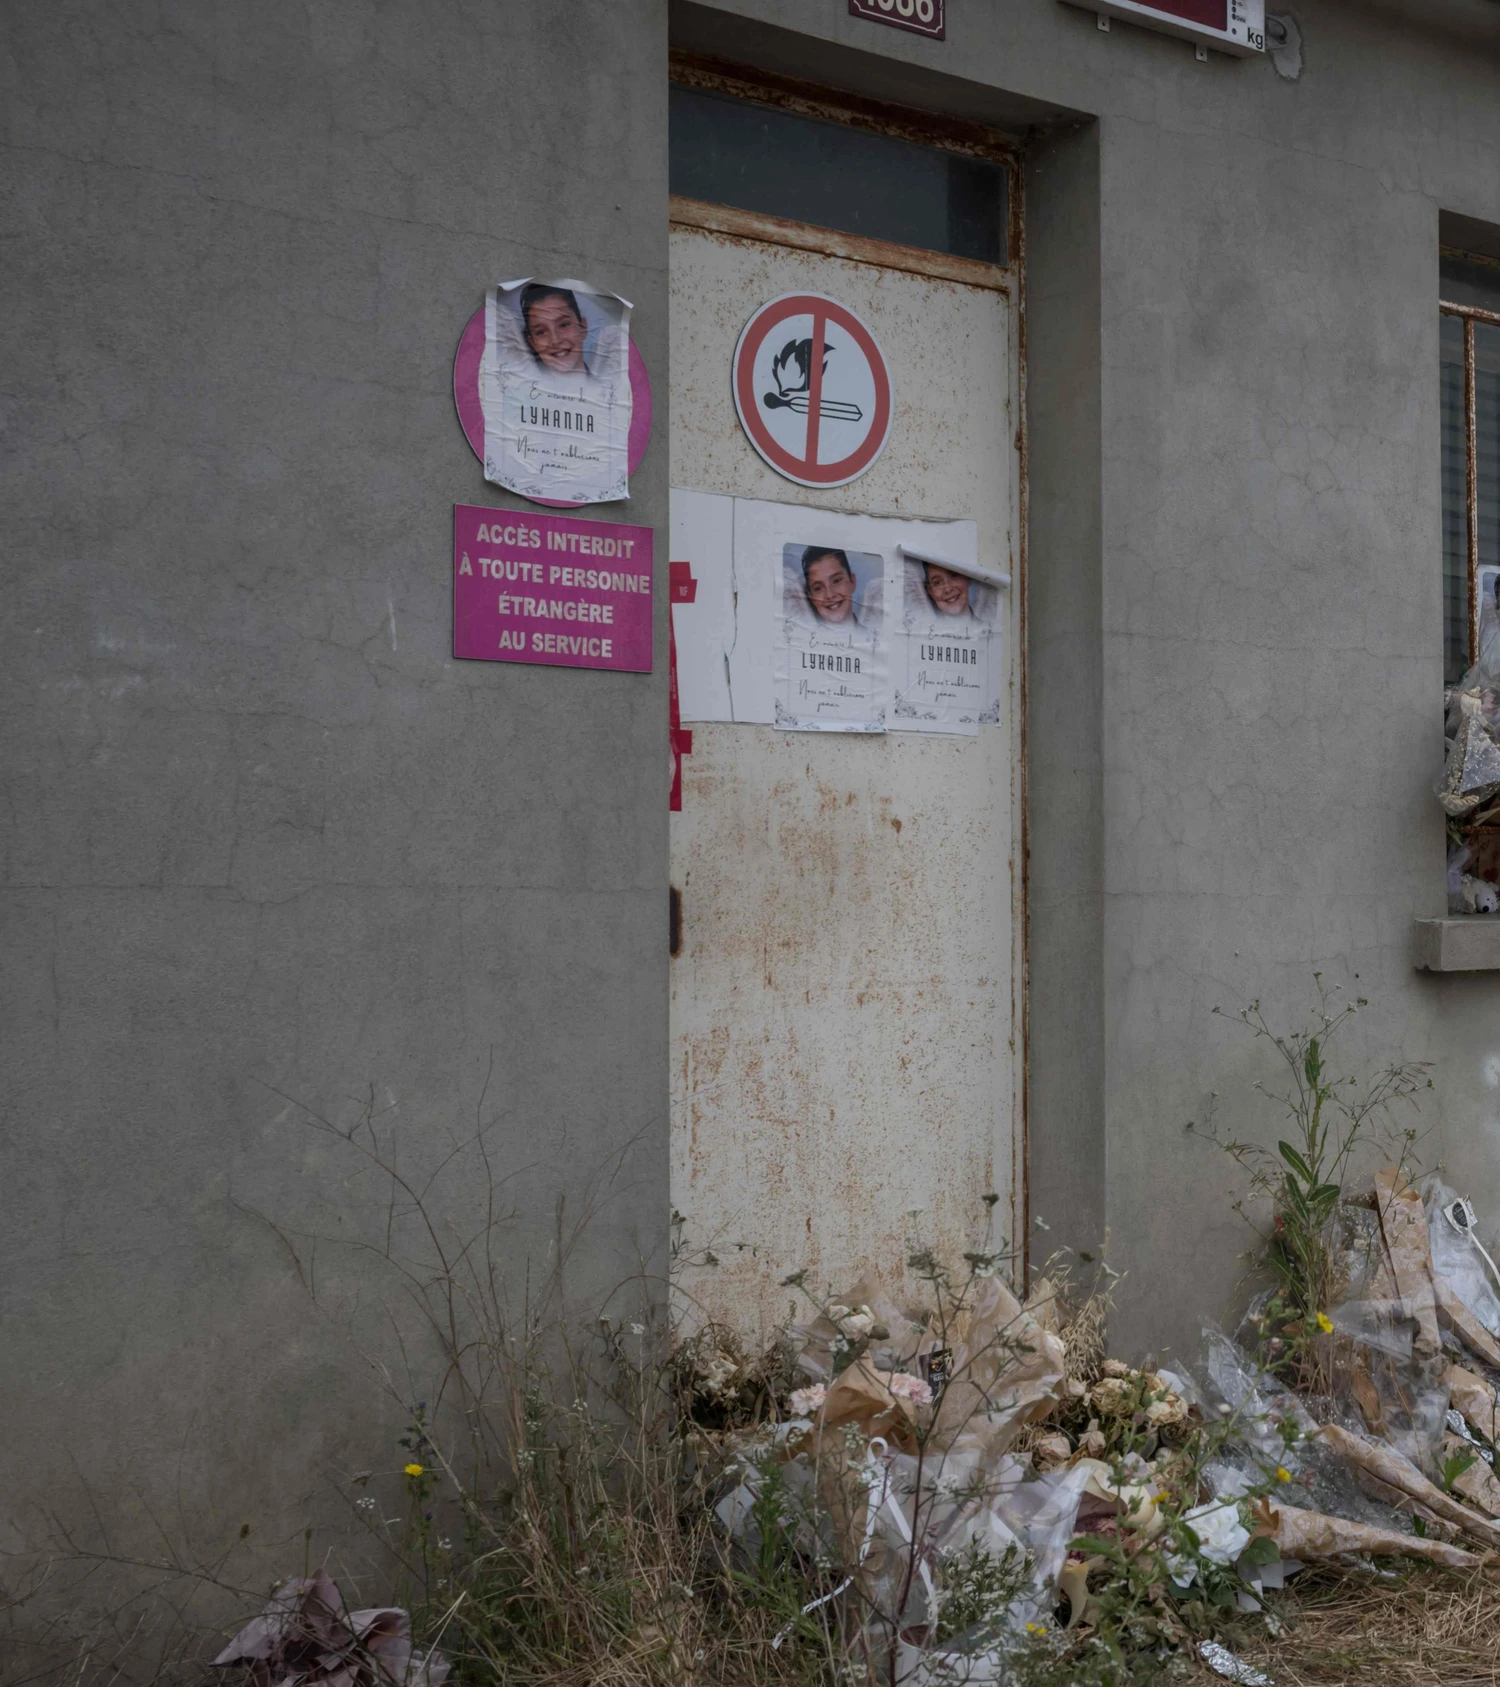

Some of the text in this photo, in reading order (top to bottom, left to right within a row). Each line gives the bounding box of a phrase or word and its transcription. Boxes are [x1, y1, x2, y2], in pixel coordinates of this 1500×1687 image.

[1247, 26, 1263, 50] kg
[520, 405, 594, 433] LYHANNA
[517, 435, 538, 460] Nous
[476, 523, 635, 559] ACCÈS INTERDIT
[459, 551, 650, 594] À TOUTE PERSONNE
[498, 591, 614, 624] ÉTRANGÈRE
[498, 630, 613, 658] AU SERVICE
[921, 644, 977, 665] LYHANNA
[802, 652, 860, 674] LYHANNA
